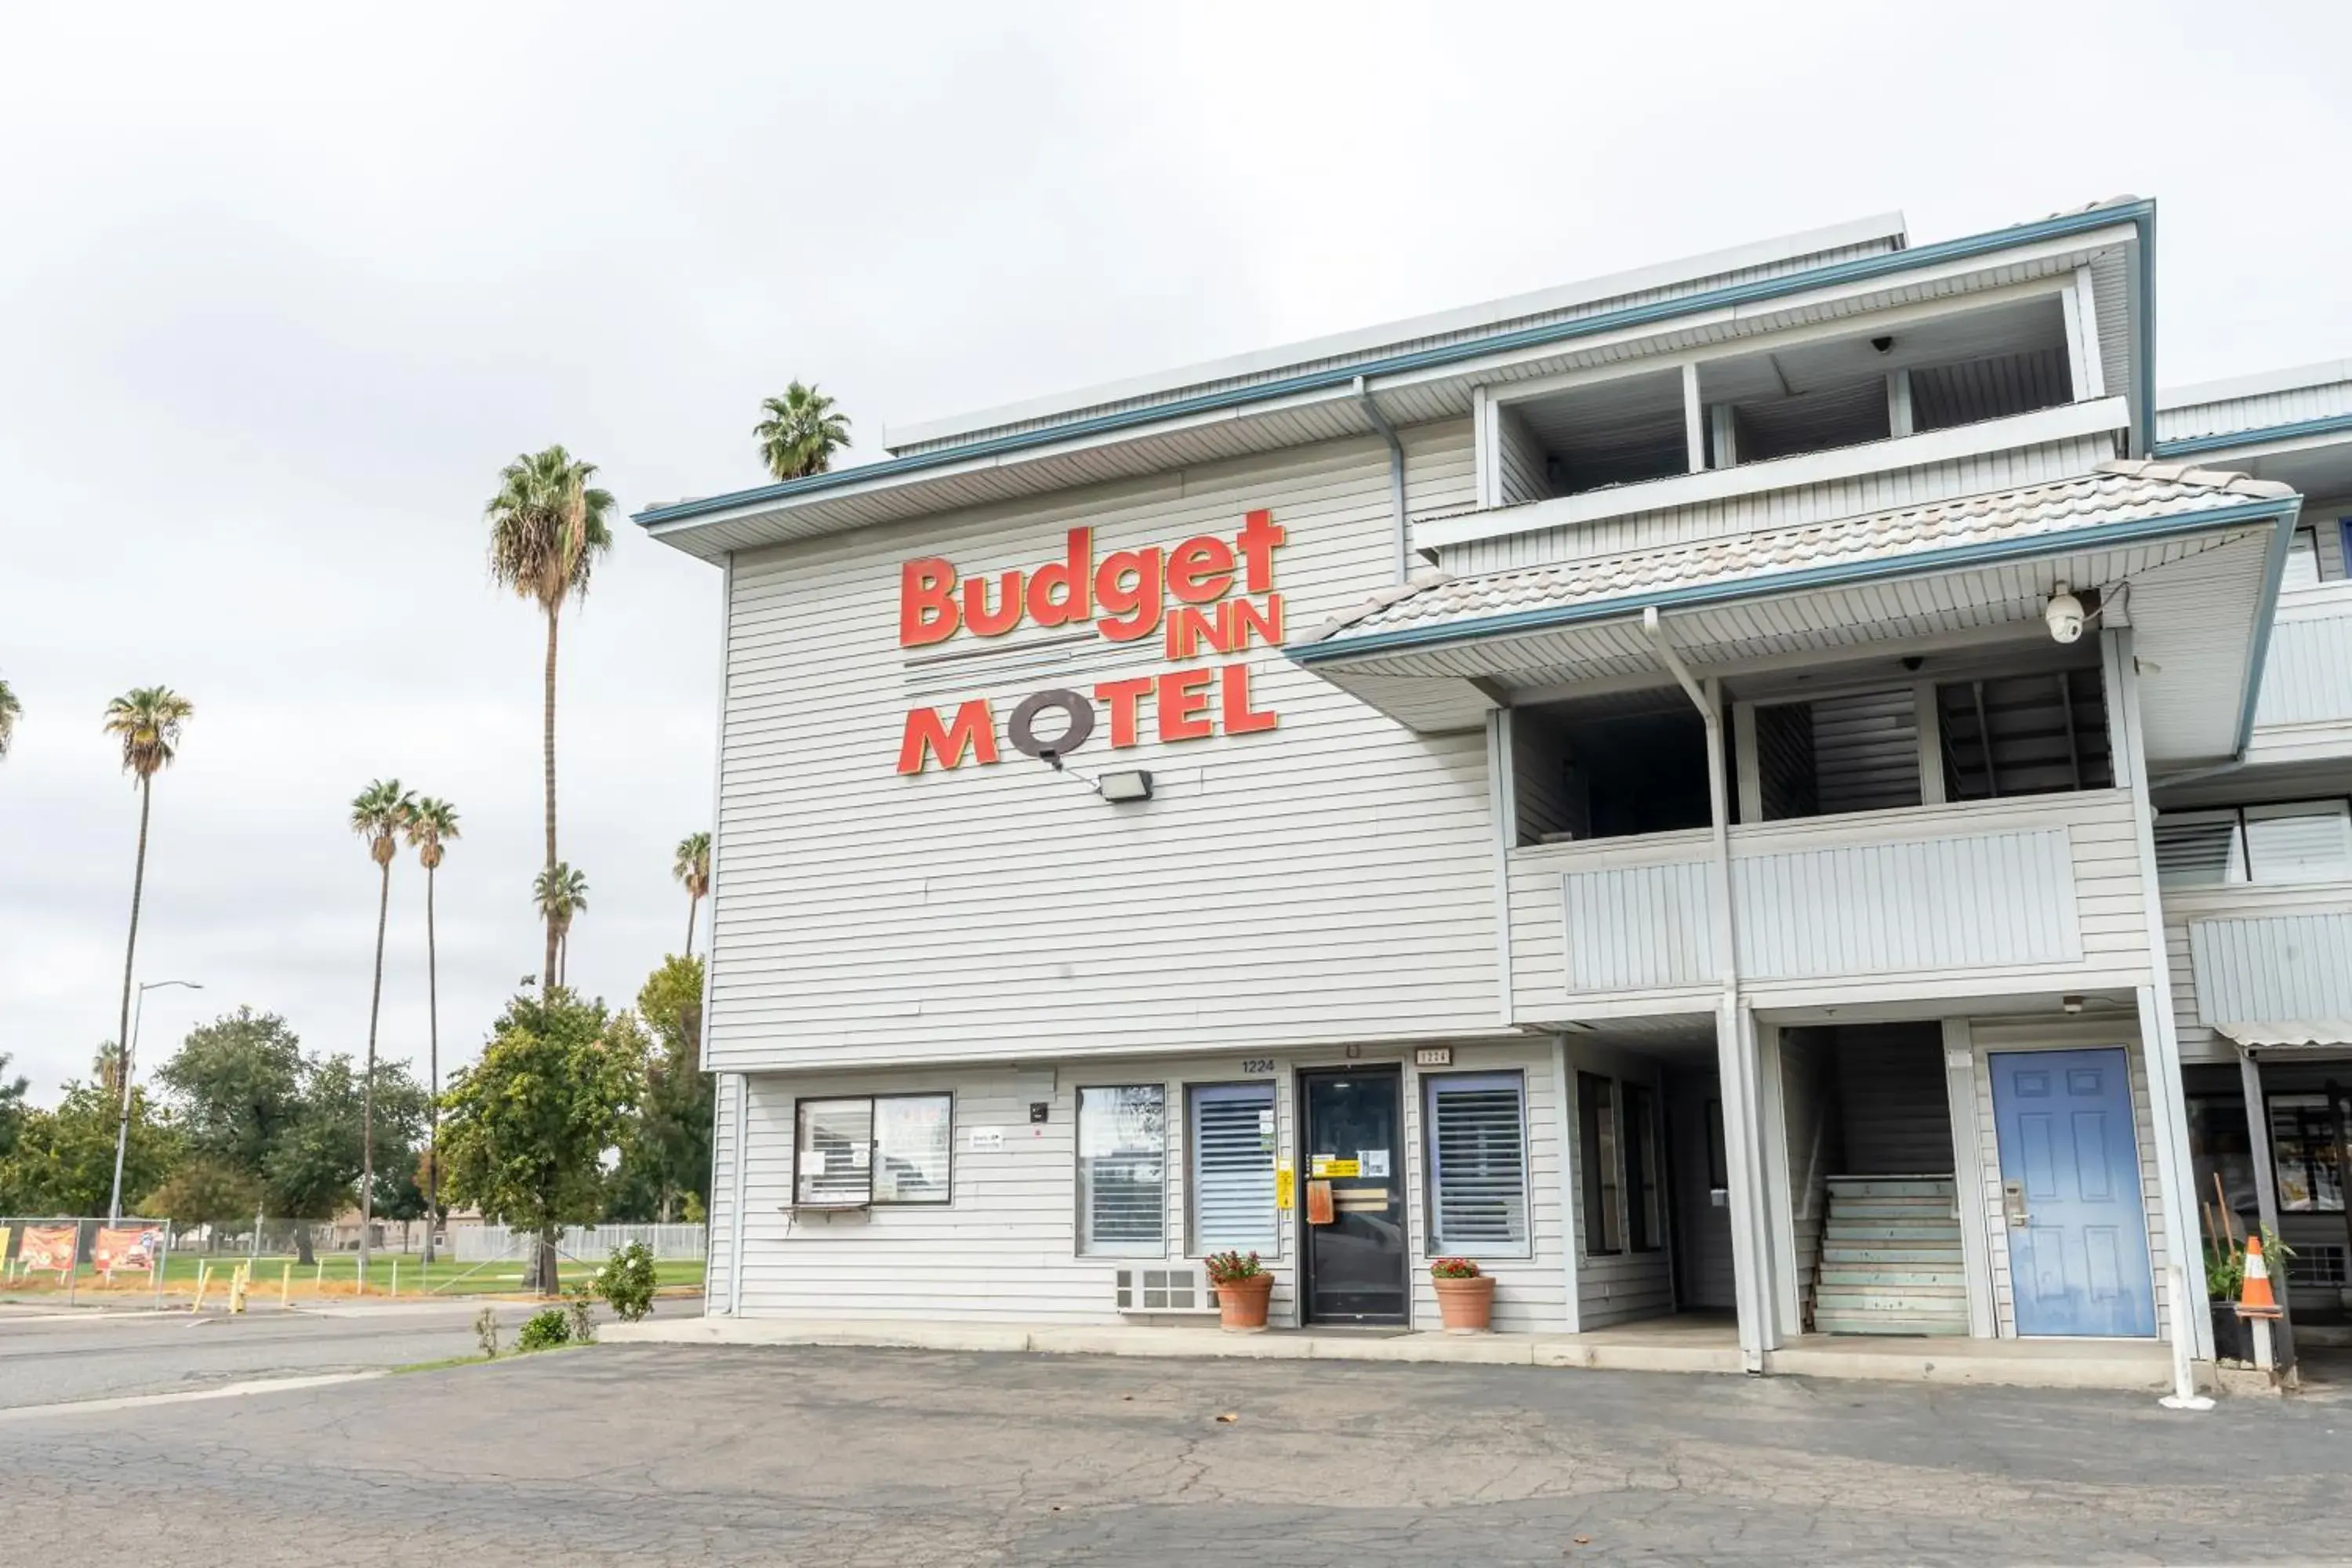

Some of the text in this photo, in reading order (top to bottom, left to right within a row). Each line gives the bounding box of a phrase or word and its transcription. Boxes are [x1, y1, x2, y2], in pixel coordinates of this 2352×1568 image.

[899, 508, 1287, 648] Budget
[1163, 593, 1285, 661] INN
[896, 663, 1280, 776] MOTEL
[1242, 1059, 1276, 1073] 1224
